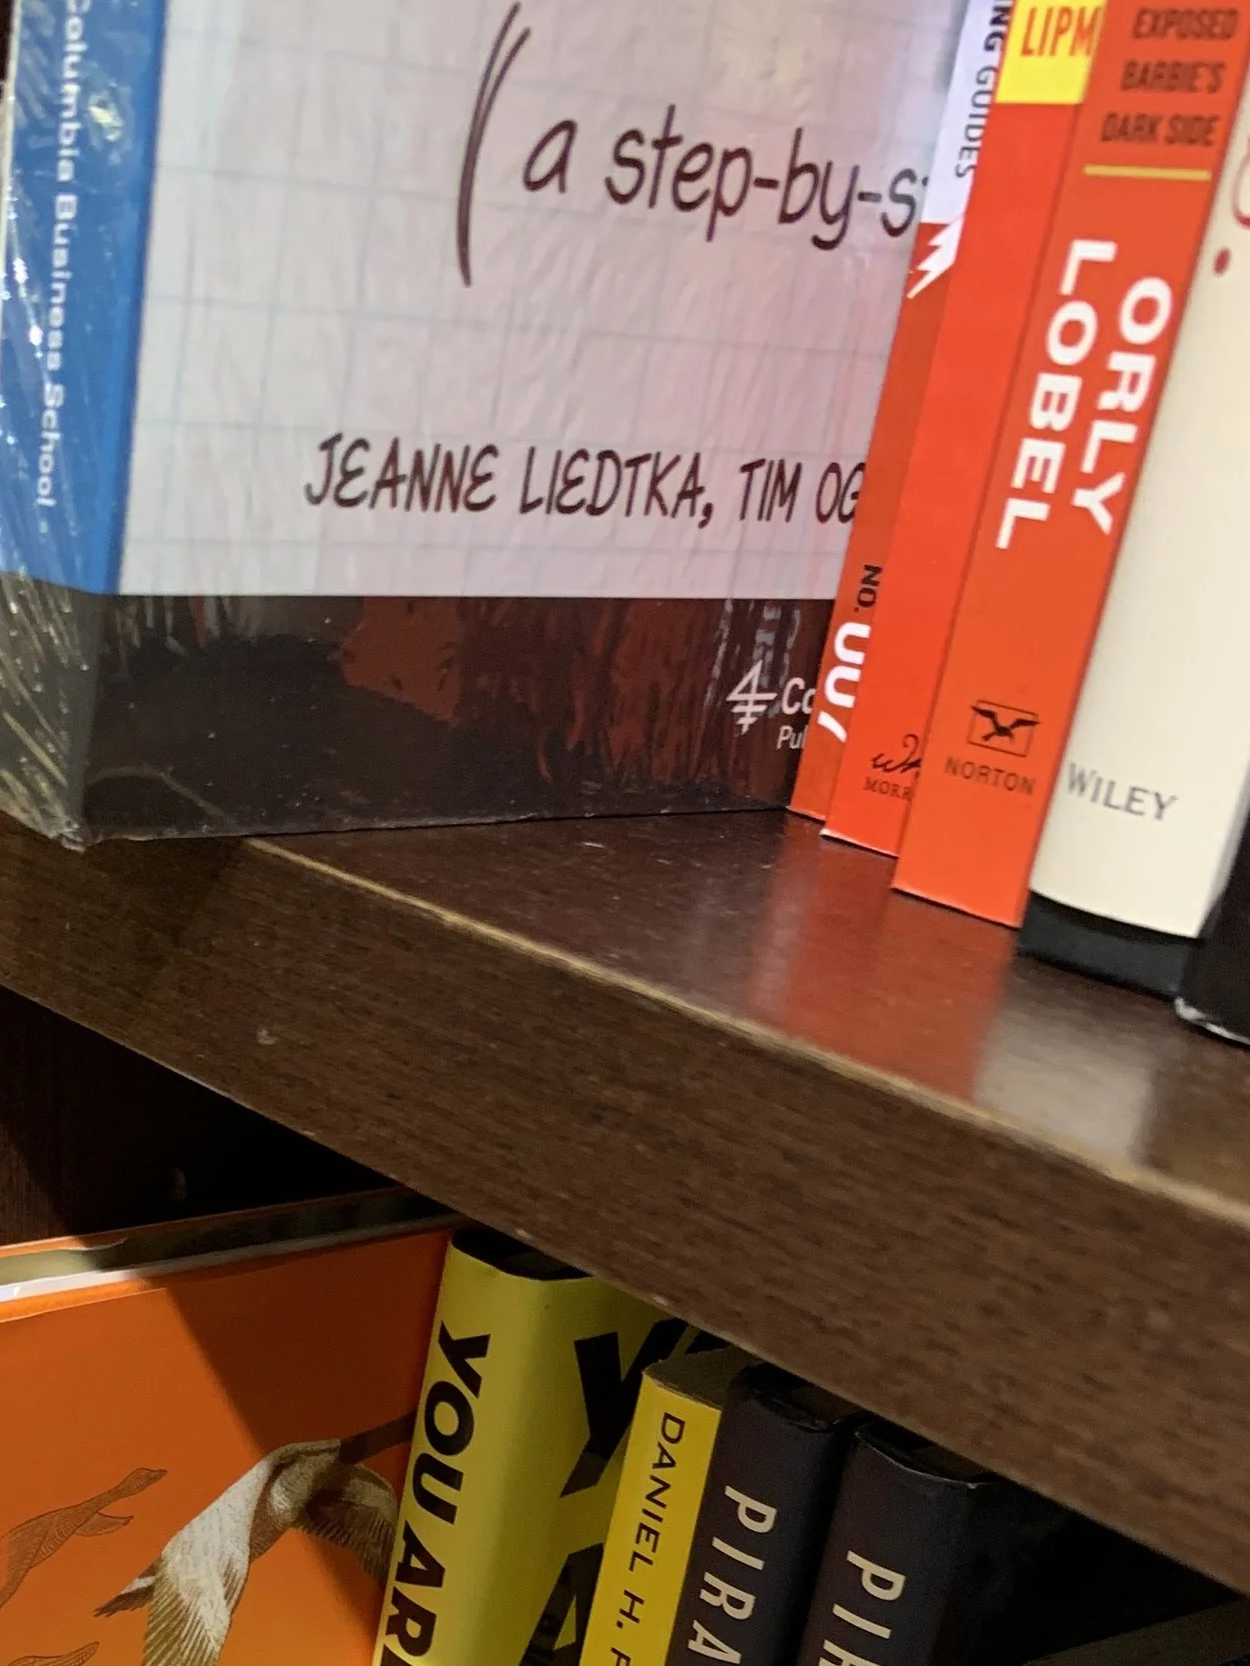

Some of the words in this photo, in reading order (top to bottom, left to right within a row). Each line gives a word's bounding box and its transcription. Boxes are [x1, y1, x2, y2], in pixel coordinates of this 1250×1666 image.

[1021, 6, 1102, 57] LIPM
[1120, 60, 1227, 93] BARBIE'S
[1133, 8, 1239, 40] EXPOSED
[59, 0, 94, 182] olumbia
[1100, 112, 1162, 143] DARK
[1165, 114, 1221, 146] SIDE
[605, 104, 929, 250] step-by-s
[42, 195, 78, 373] Business
[36, 379, 64, 508] School
[994, 239, 1117, 550] LOBEL
[1069, 275, 1173, 535] ORLY
[305, 432, 498, 512] JEANNE
[518, 445, 715, 529] LIEDTKA,
[738, 458, 799, 524] TIM
[863, 776, 915, 801] MORR
[945, 756, 1036, 796] NORTON
[1066, 761, 1177, 823] WILEY
[411, 1320, 491, 1525] YOU
[627, 1411, 686, 1573] DANIEL
[612, 1594, 645, 1632] H.
[688, 1484, 777, 1665] PIRA
